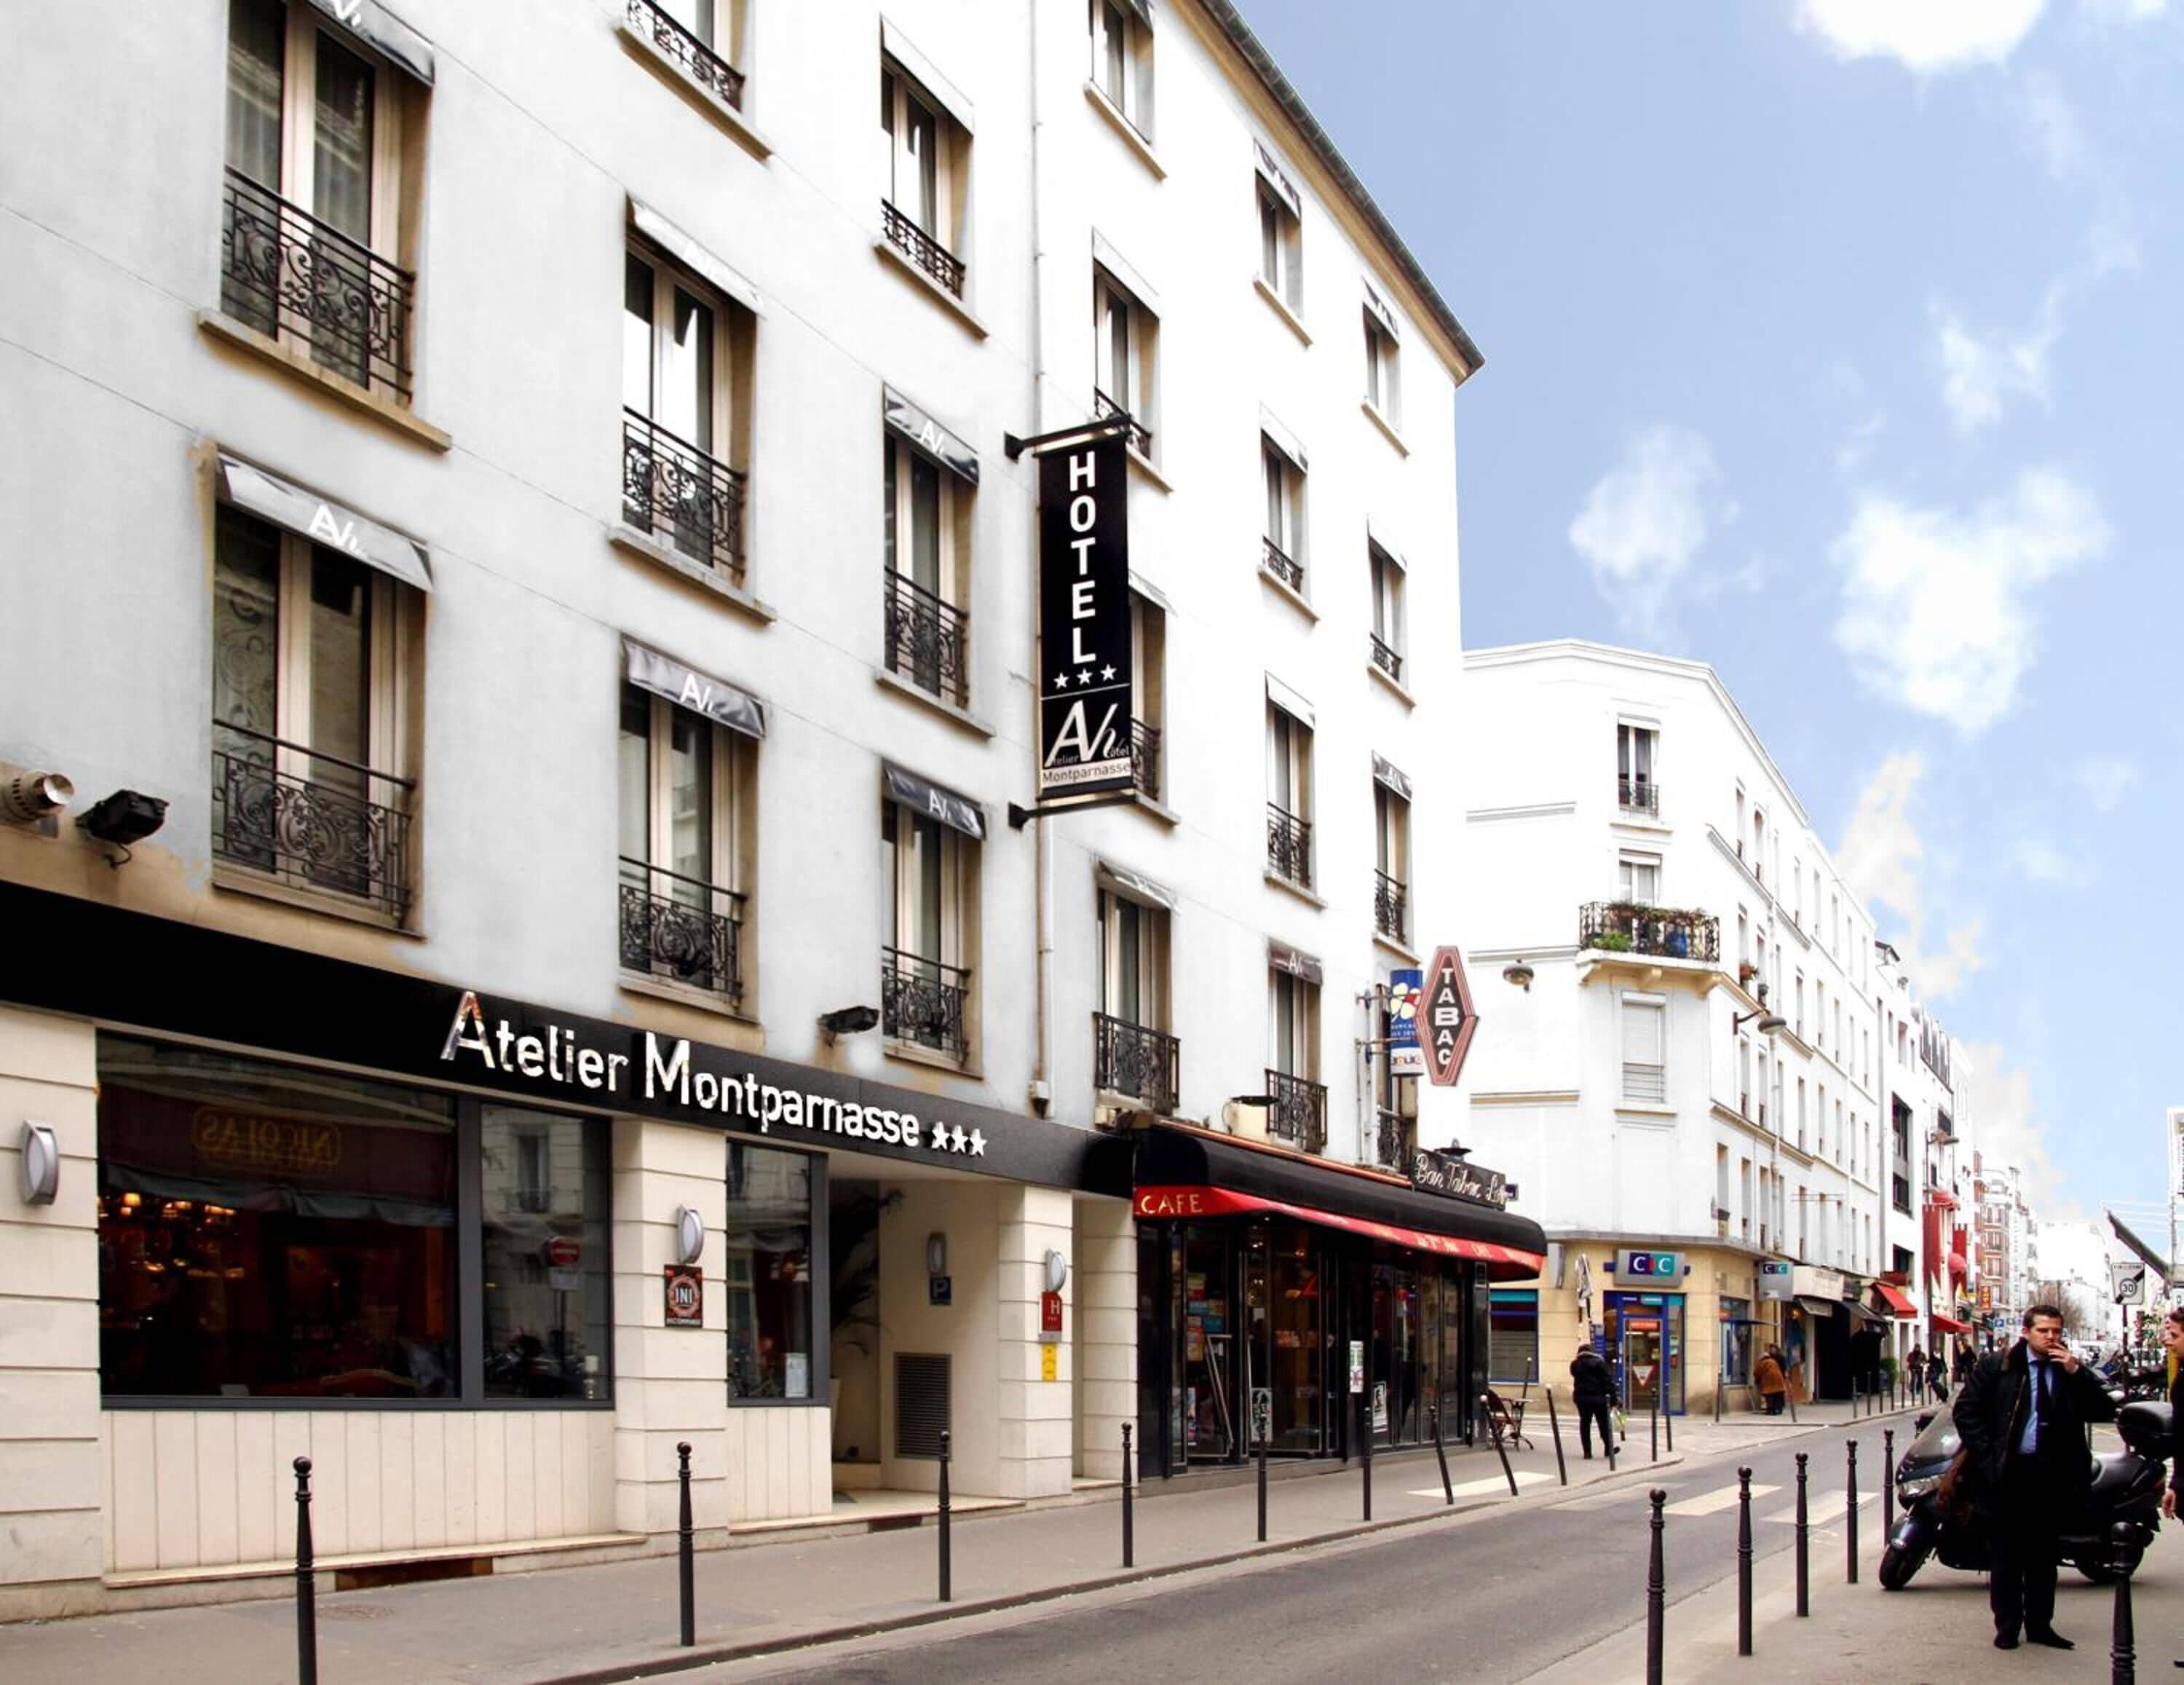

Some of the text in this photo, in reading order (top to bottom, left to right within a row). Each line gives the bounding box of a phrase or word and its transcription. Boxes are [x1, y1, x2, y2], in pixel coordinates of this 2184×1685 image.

[1069, 450, 1096, 665] HOTEL
[1042, 762, 1131, 783] Montparnasse
[1434, 967, 1460, 1065] TABAC
[440, 990, 919, 1148] Atelier Montparnasse
[1141, 1194, 1203, 1214] CAFE
[1051, 1300, 1061, 1315] H
